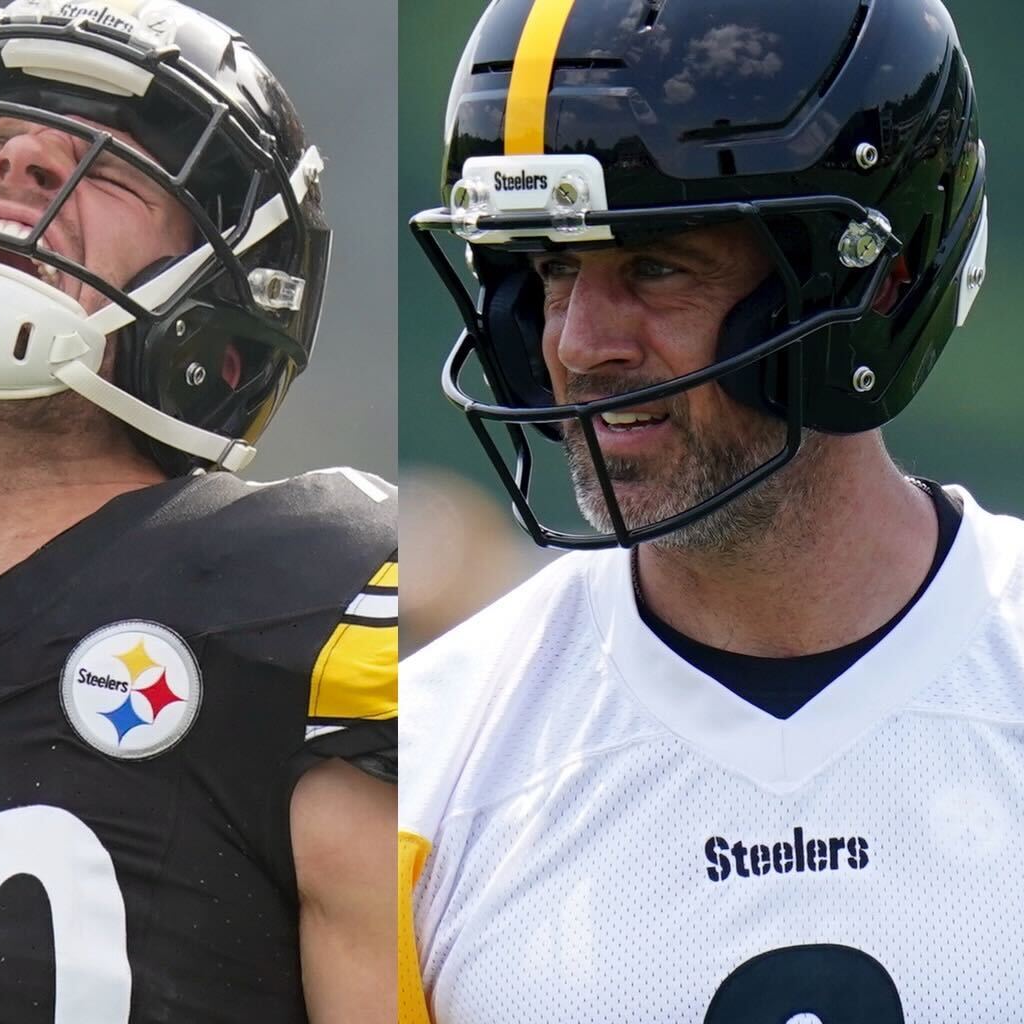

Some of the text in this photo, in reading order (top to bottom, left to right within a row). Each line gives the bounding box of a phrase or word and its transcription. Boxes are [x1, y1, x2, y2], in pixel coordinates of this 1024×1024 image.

[493, 169, 549, 192] Steelers
[77, 668, 130, 694] Steelers
[704, 826, 870, 883] Steelers
